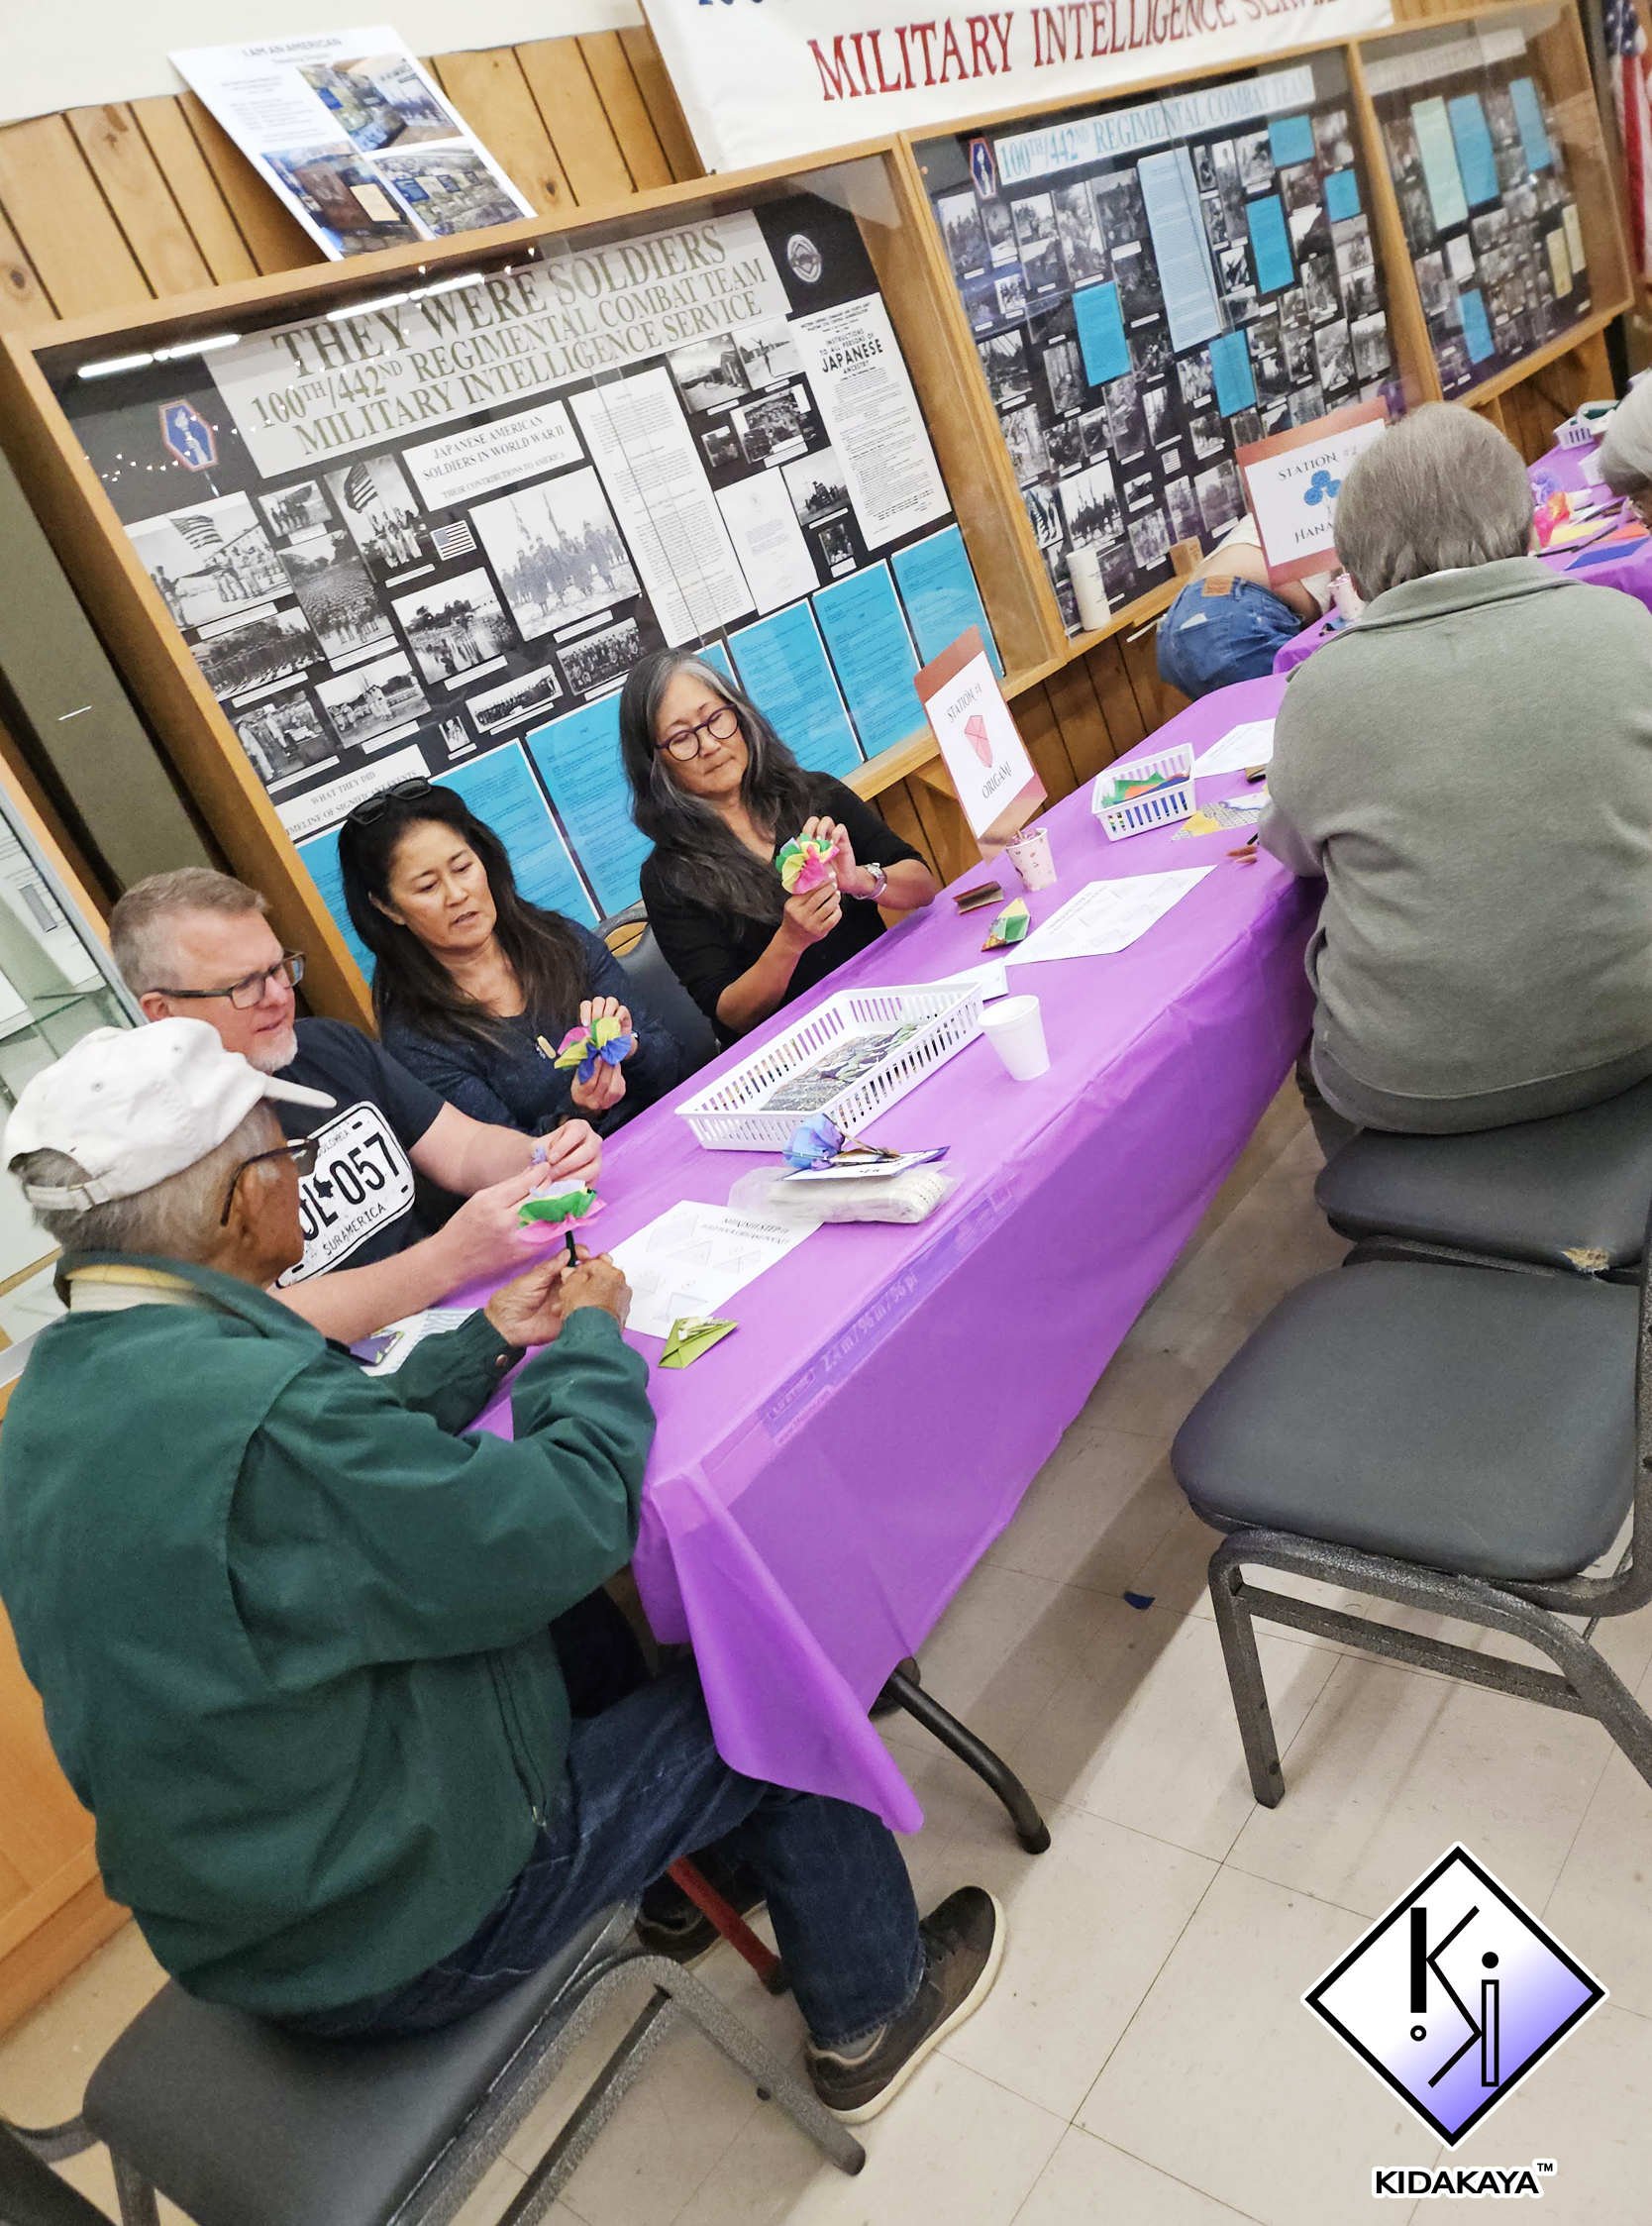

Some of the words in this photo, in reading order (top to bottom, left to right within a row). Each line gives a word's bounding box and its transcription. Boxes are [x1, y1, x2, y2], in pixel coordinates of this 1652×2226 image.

[285, 37, 343, 53] AMERICAN
[807, 11, 1014, 101] MILITARY
[1030, 0, 1237, 67] INTELLIGENCE
[1092, 101, 1205, 154] REGIMENTAL
[1206, 78, 1271, 125] COMBAT
[1272, 68, 1312, 106] TEAM
[271, 300, 411, 378] THEY
[420, 270, 547, 339] WERE
[548, 224, 726, 306] SOLDIERS
[407, 306, 597, 382] REGIMENTAL
[597, 276, 698, 327] COMBAT
[699, 257, 768, 298] TEAM
[291, 380, 455, 456] MILITARY
[459, 320, 663, 404] INTELLIGENCE
[663, 289, 763, 343] SERVICE
[822, 338, 884, 373] JAPANESE
[422, 455, 477, 481] SOLDIERS
[478, 450, 490, 463] IN
[490, 437, 531, 458] WORLD
[531, 429, 556, 444] WAR
[556, 424, 566, 436] II
[433, 433, 488, 460] JAPANESE
[489, 416, 544, 446] AMERICAN
[443, 484, 466, 499] THEIR
[466, 467, 524, 491] CONTRIBUTIONS
[524, 461, 535, 471] TO
[535, 451, 567, 468] AMERICA
[1278, 451, 1341, 481] STATION
[946, 688, 978, 724] STATION
[310, 788, 338, 805] WHAT
[338, 779, 360, 794] THEY
[360, 771, 376, 784] DID
[981, 761, 1012, 799] ORIGAMI
[285, 812, 323, 836] IMELINE
[323, 807, 335, 818] OF
[329, 1131, 400, 1206] 057
[322, 1202, 387, 1256] SURAMERICA
